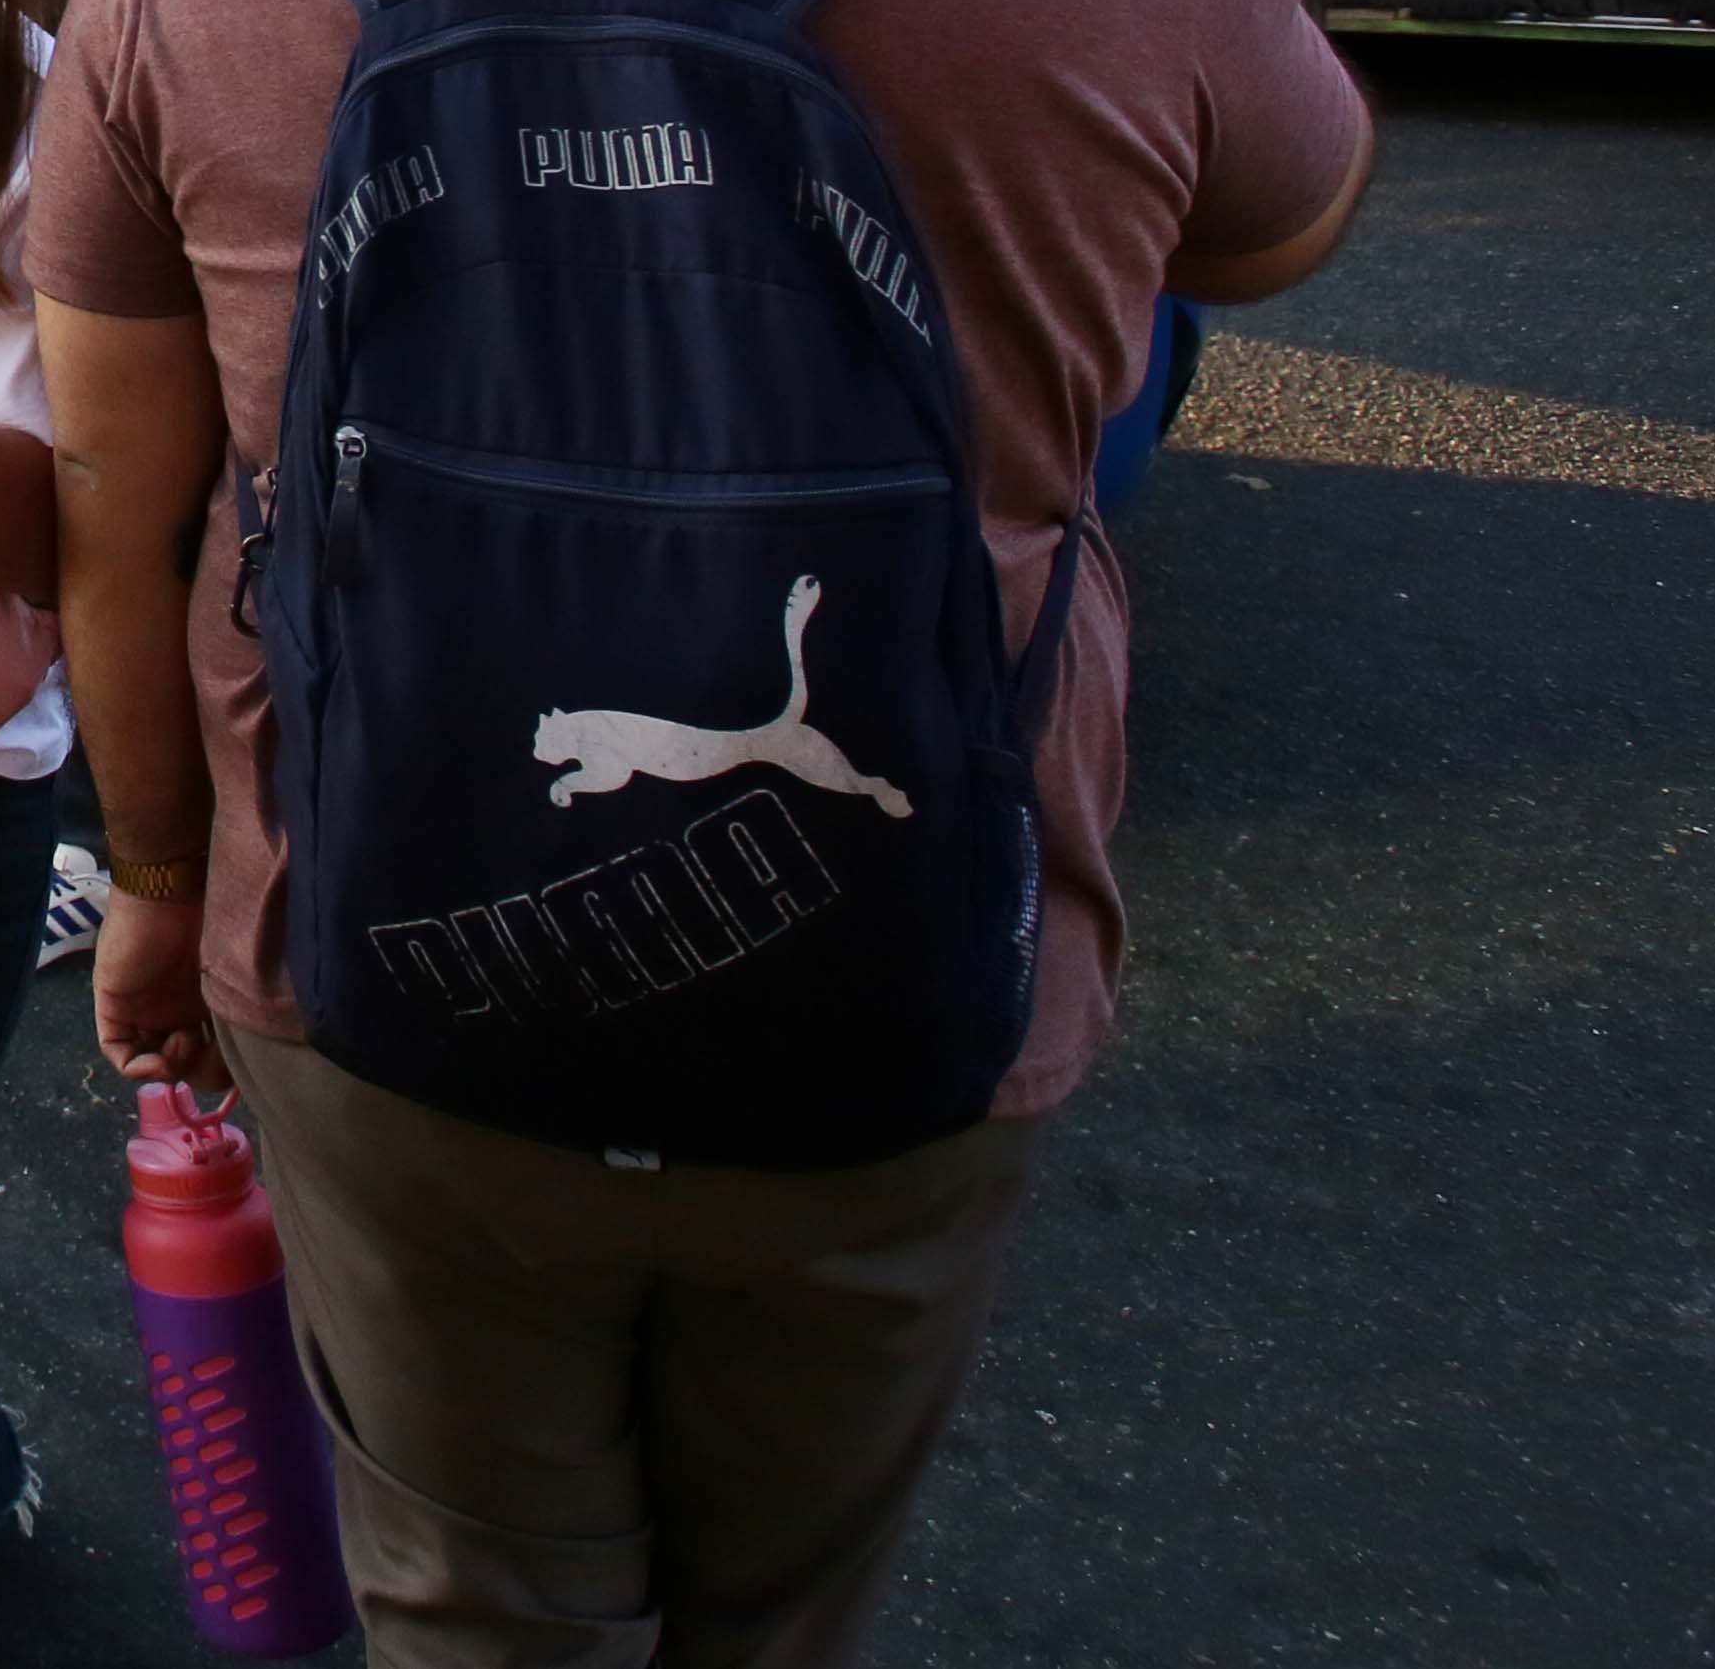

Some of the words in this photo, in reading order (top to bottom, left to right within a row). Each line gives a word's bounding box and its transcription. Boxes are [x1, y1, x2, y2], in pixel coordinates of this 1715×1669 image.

[316, 143, 447, 310] PUMA
[518, 121, 715, 191] PUMA
[367, 787, 842, 1025] PUMA
